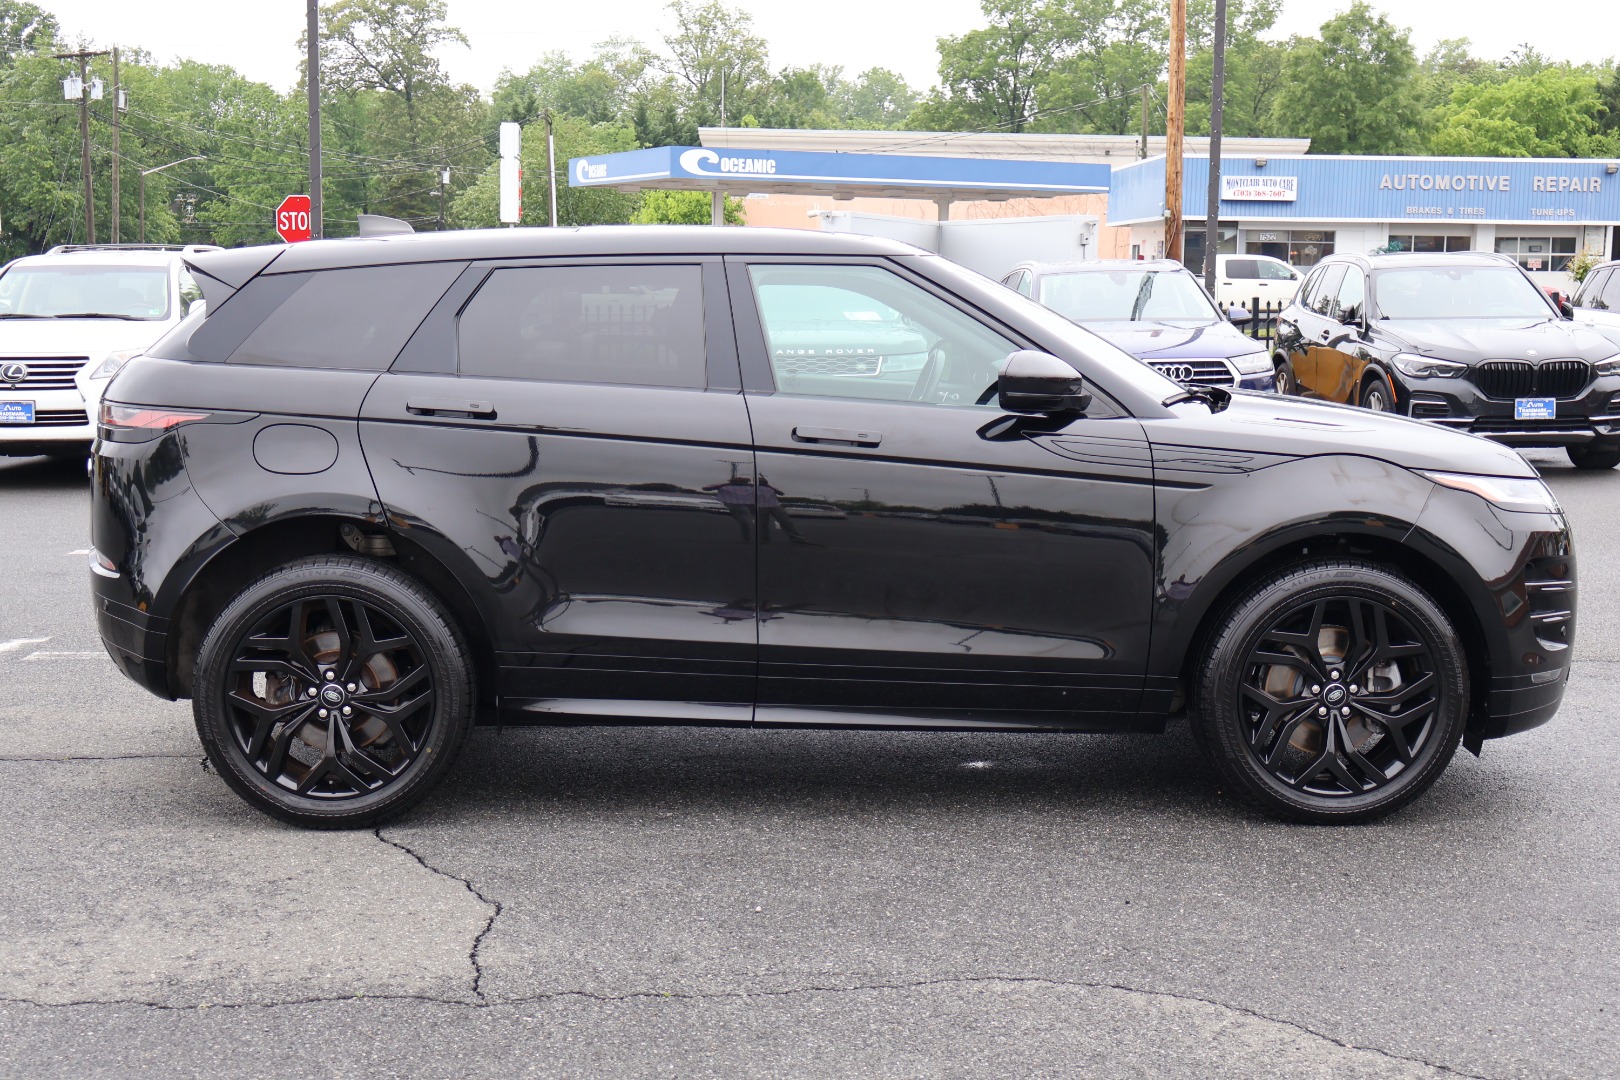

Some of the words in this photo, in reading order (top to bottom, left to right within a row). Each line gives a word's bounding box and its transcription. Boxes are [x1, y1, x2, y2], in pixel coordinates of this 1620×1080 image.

[720, 157, 776, 174] OCEANIC
[1226, 178, 1260, 190] MONTCLAIR
[1262, 178, 1278, 187] AUTO
[1279, 179, 1294, 191] CARE
[1379, 174, 1511, 192] AUTOMOTIVE
[1533, 176, 1602, 193] REPAIR
[1406, 206, 1442, 215] BRAKES
[1447, 207, 1453, 215] &
[1459, 207, 1485, 215] TIRES
[1530, 208, 1575, 216] TUNE-UPS
